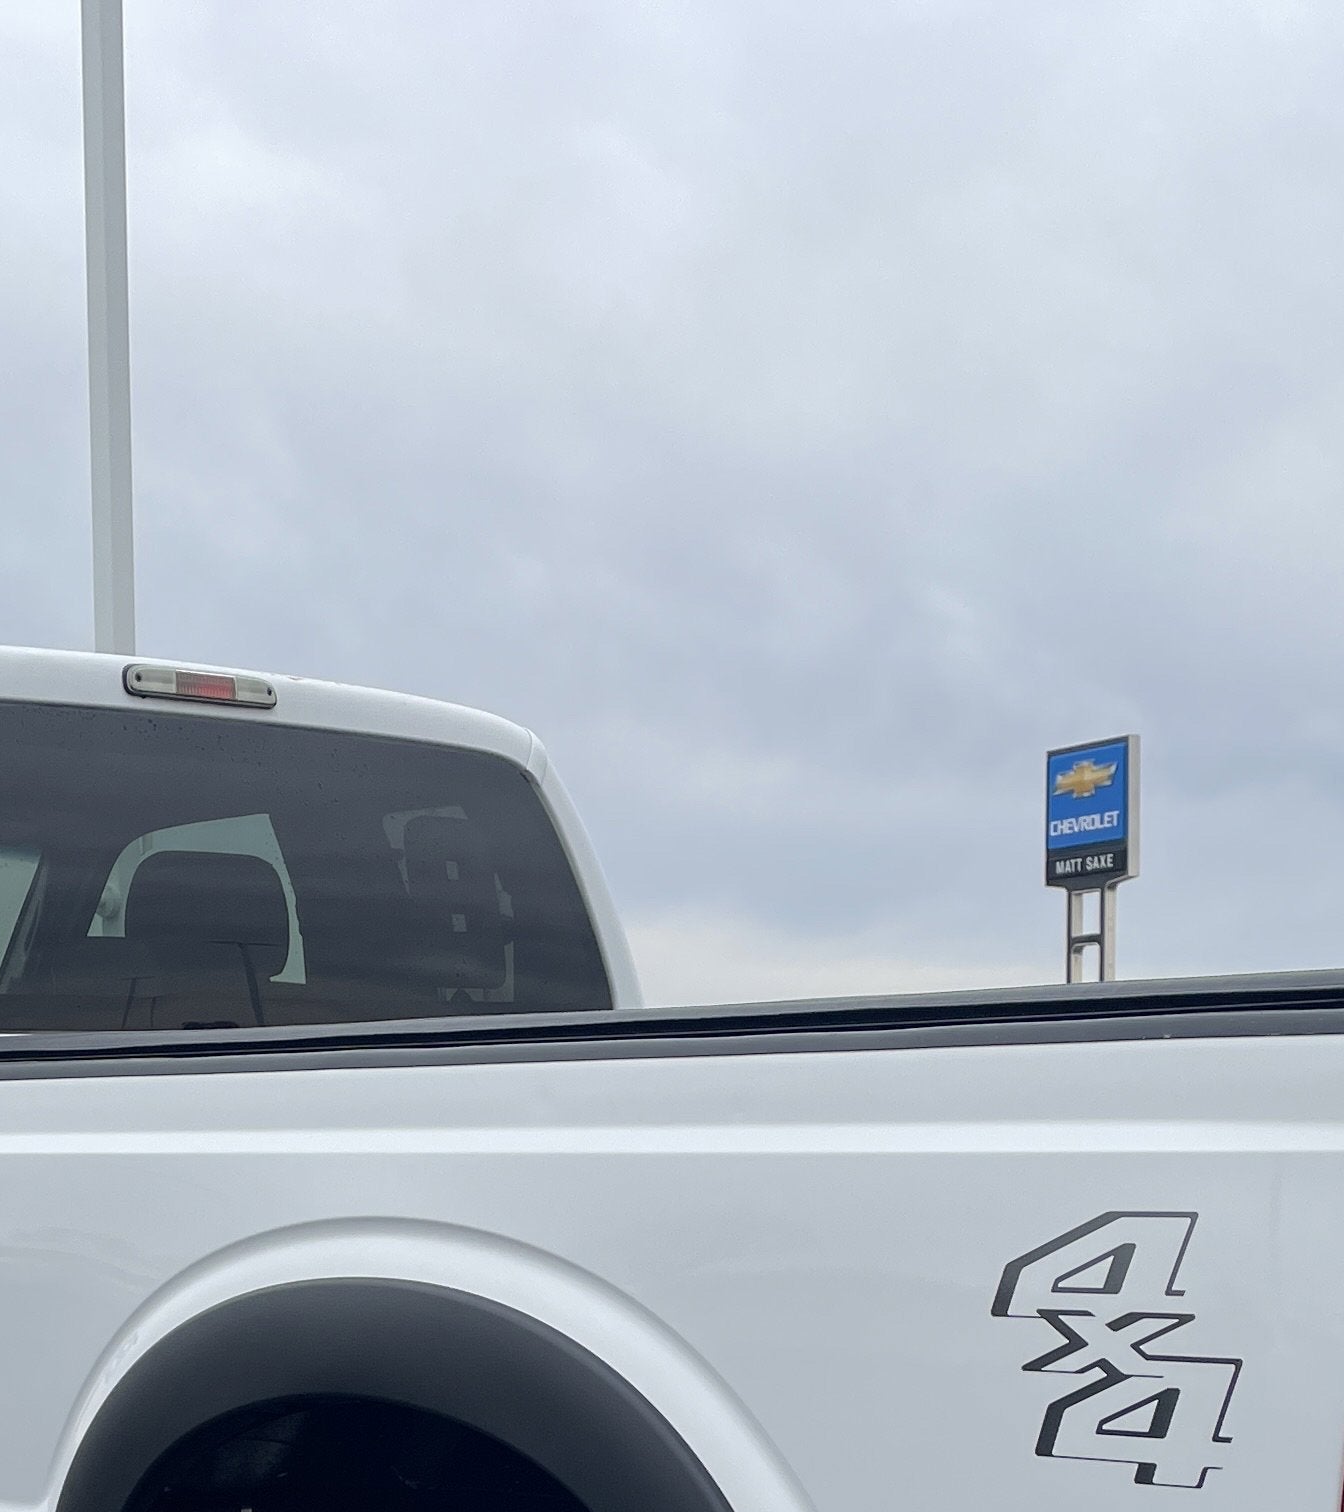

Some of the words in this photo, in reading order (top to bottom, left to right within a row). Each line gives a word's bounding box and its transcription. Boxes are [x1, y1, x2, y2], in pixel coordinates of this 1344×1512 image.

[1049, 811, 1119, 836] CHEVROLET
[1055, 857, 1083, 874] MATT
[1086, 853, 1115, 870] SAXE
